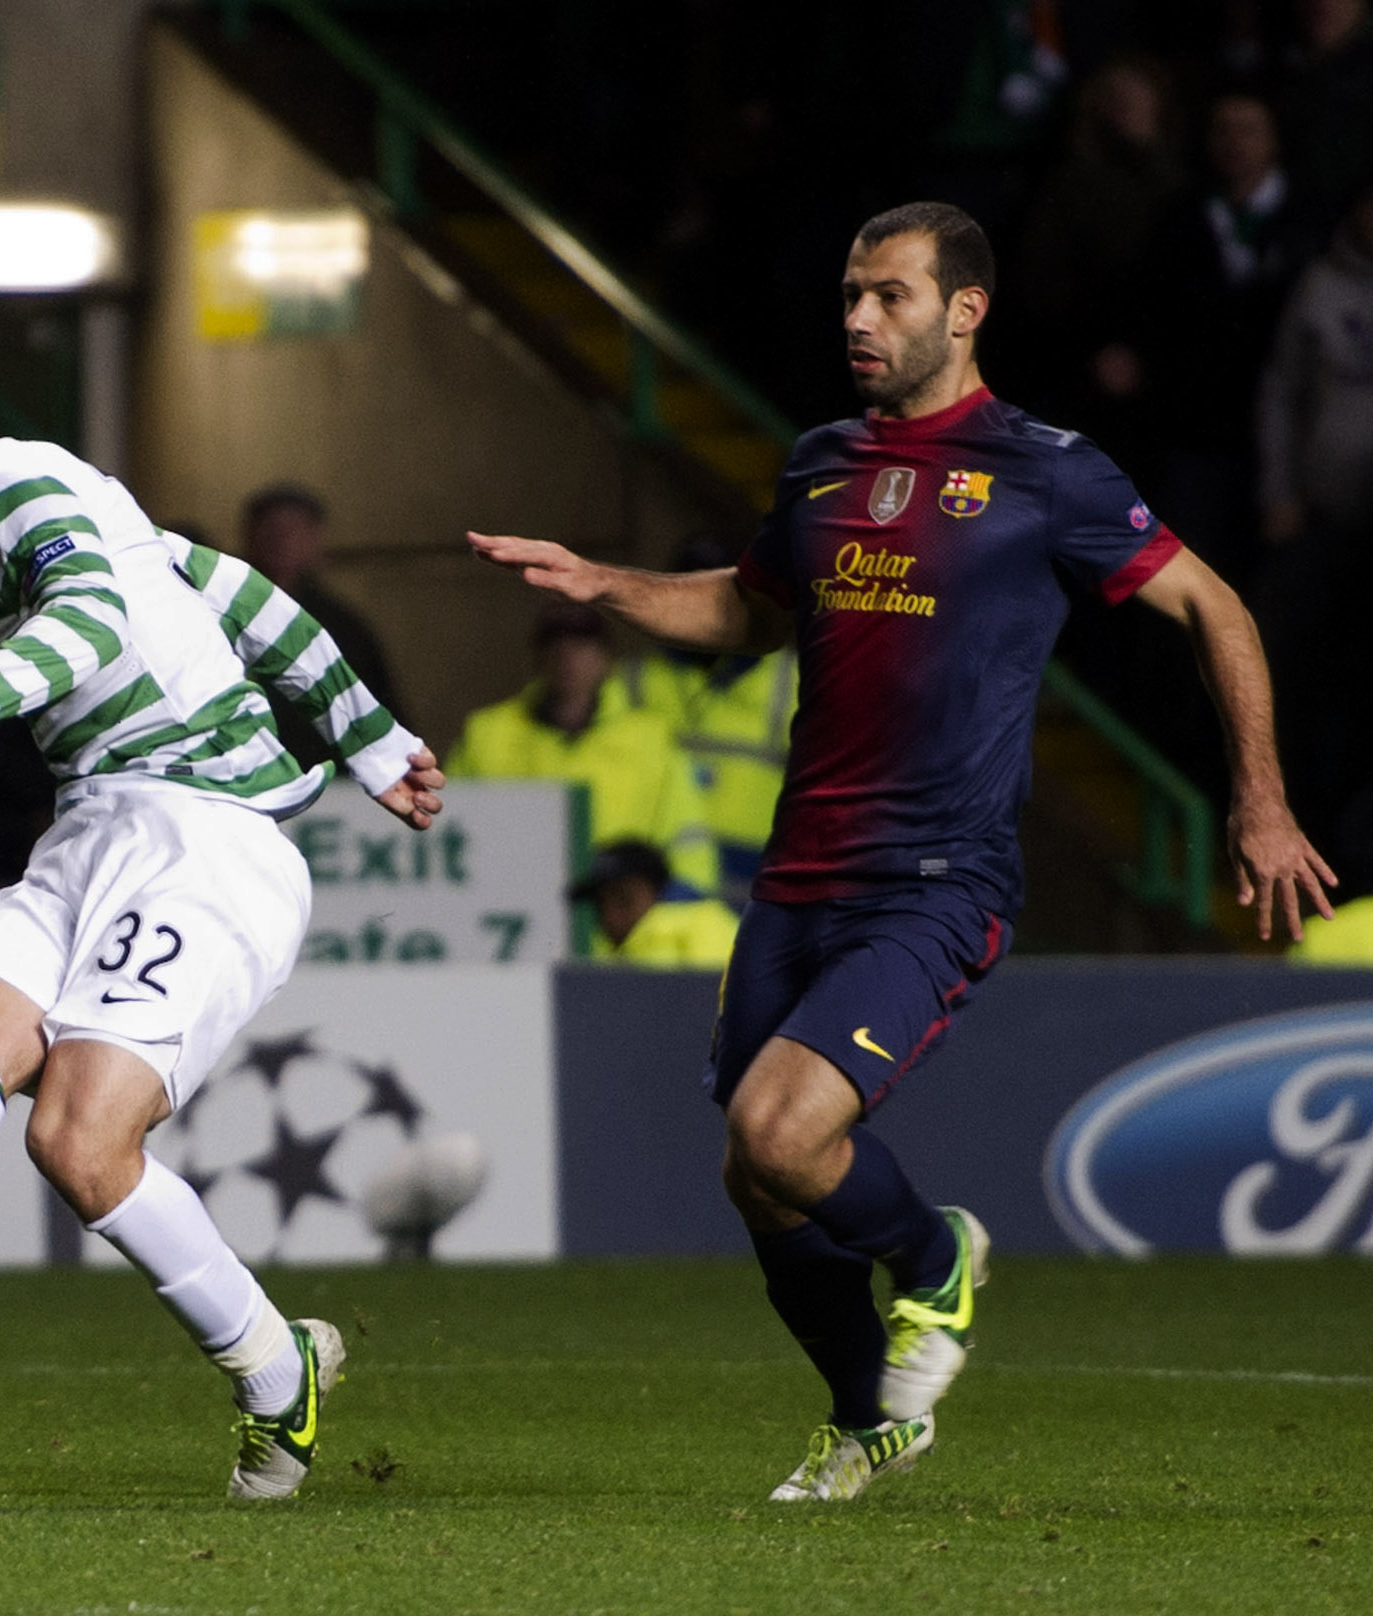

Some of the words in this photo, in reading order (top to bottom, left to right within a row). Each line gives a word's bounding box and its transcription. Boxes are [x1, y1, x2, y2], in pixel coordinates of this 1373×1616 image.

[835, 541, 917, 587] Qatar
[810, 578, 936, 617] Foundation
[294, 816, 467, 885] Exit
[97, 911, 183, 996] 32
[305, 914, 447, 963] ate
[478, 909, 530, 963] 7
